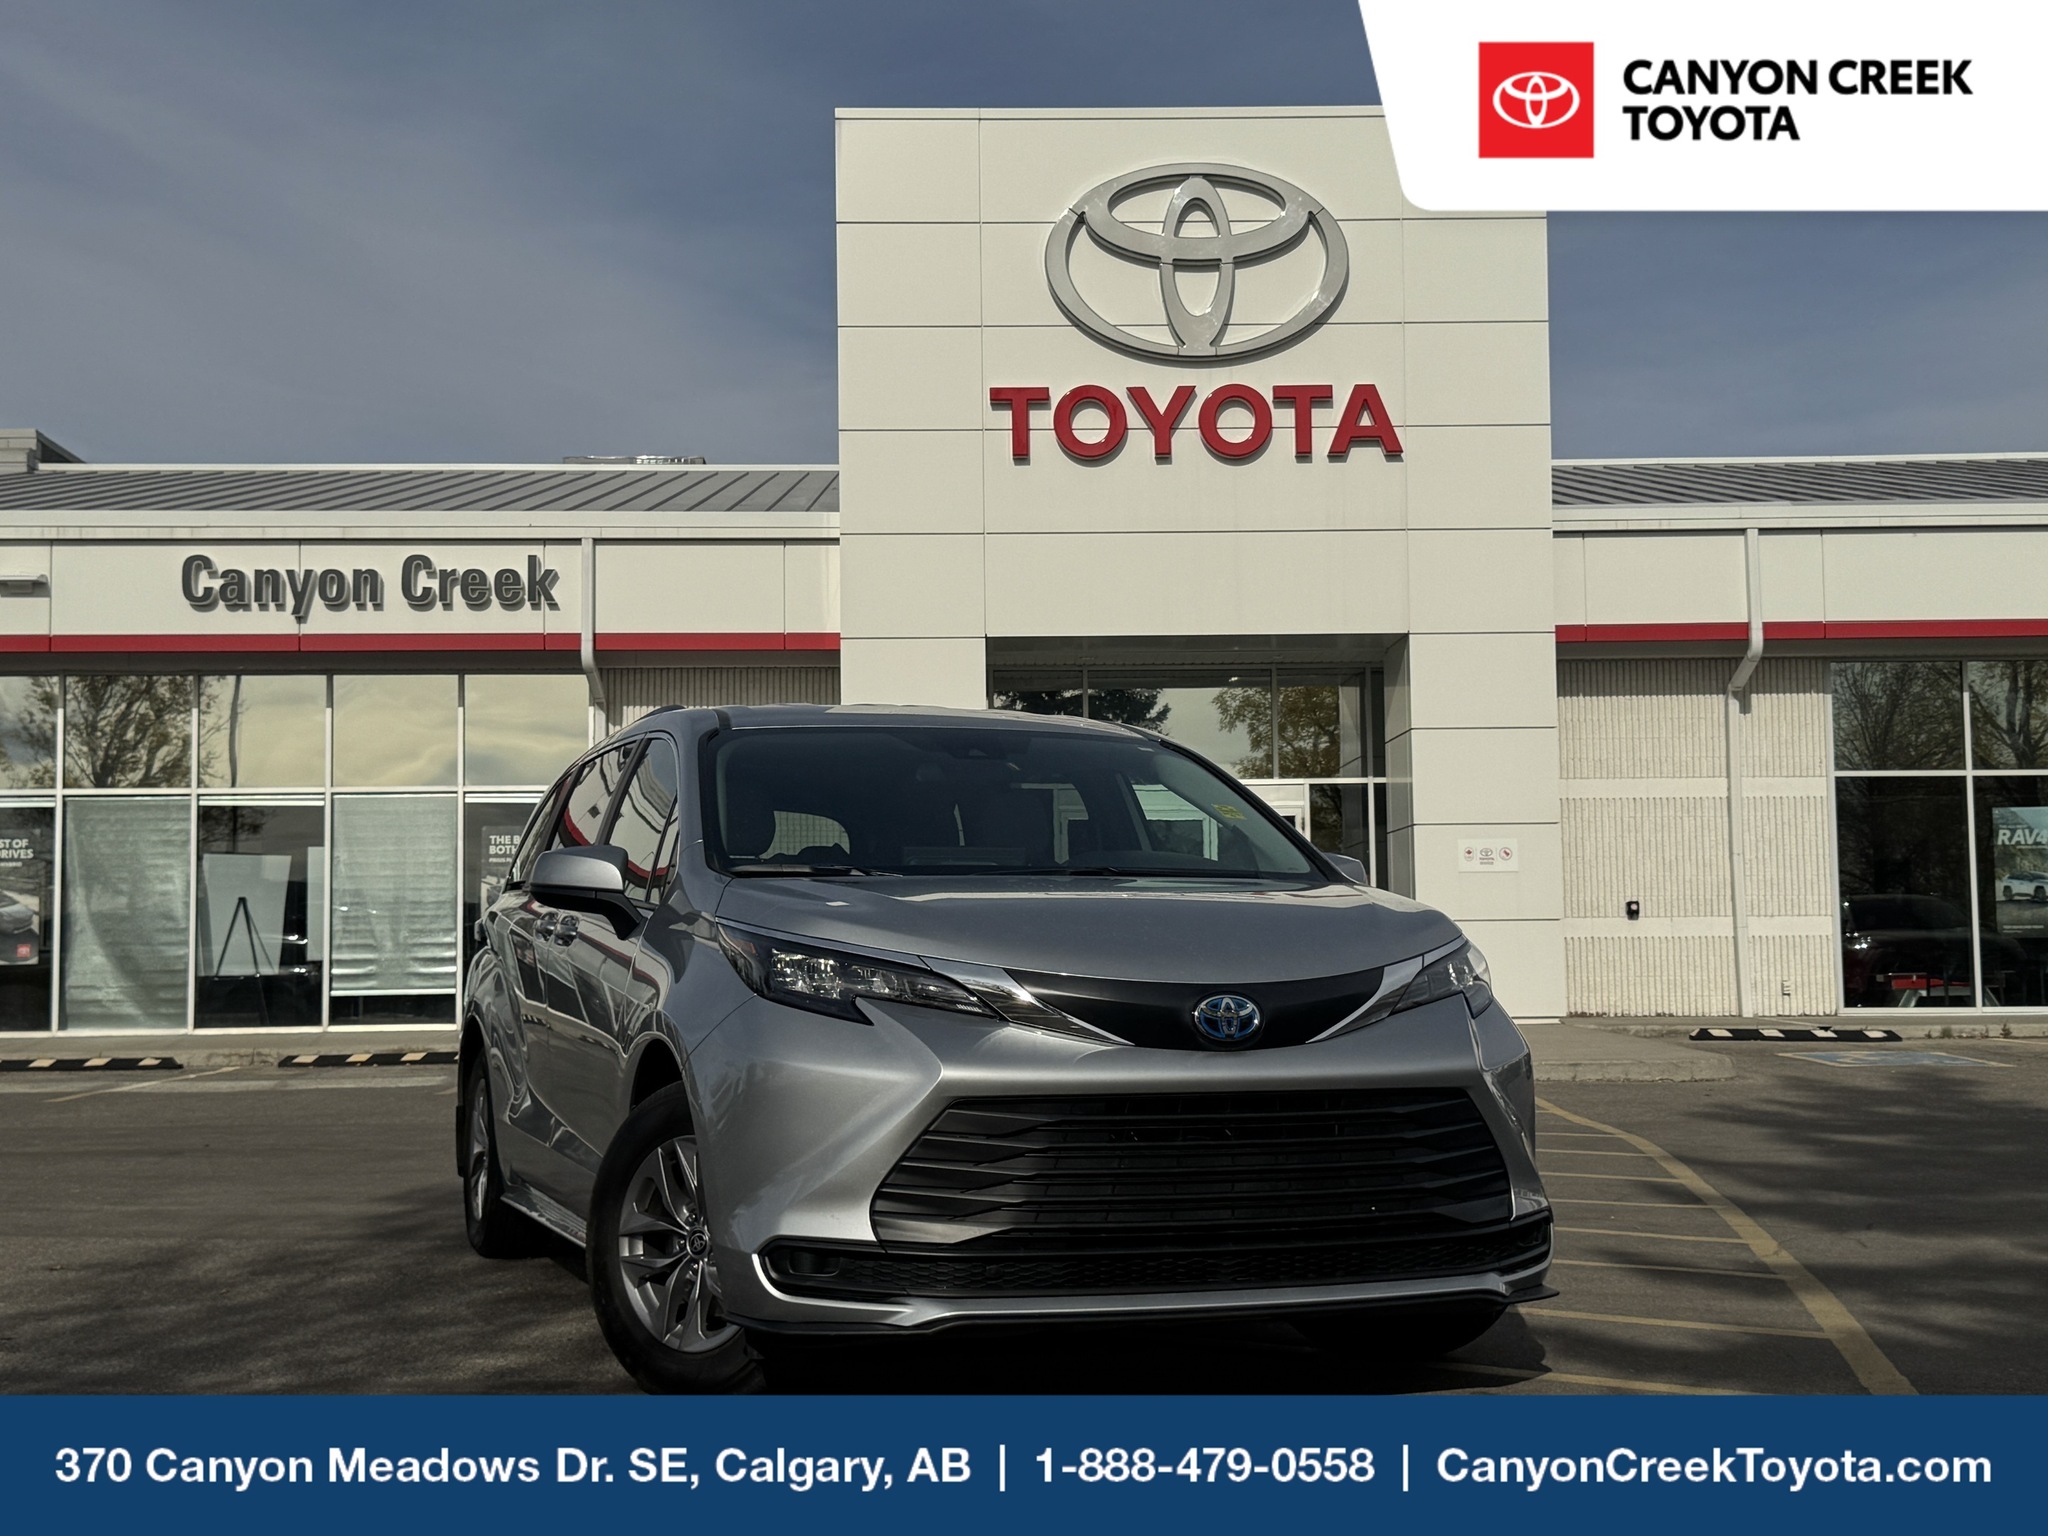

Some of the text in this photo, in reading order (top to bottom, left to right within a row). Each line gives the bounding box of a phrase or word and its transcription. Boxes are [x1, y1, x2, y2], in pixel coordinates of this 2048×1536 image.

[990, 384, 1403, 457] TOYOTA
[181, 554, 558, 618] Canyon Creek
[12, 838, 29, 848] OF
[489, 835, 511, 844] THE
[1997, 829, 2048, 845] RAV4
[0, 849, 34, 858] RIVES
